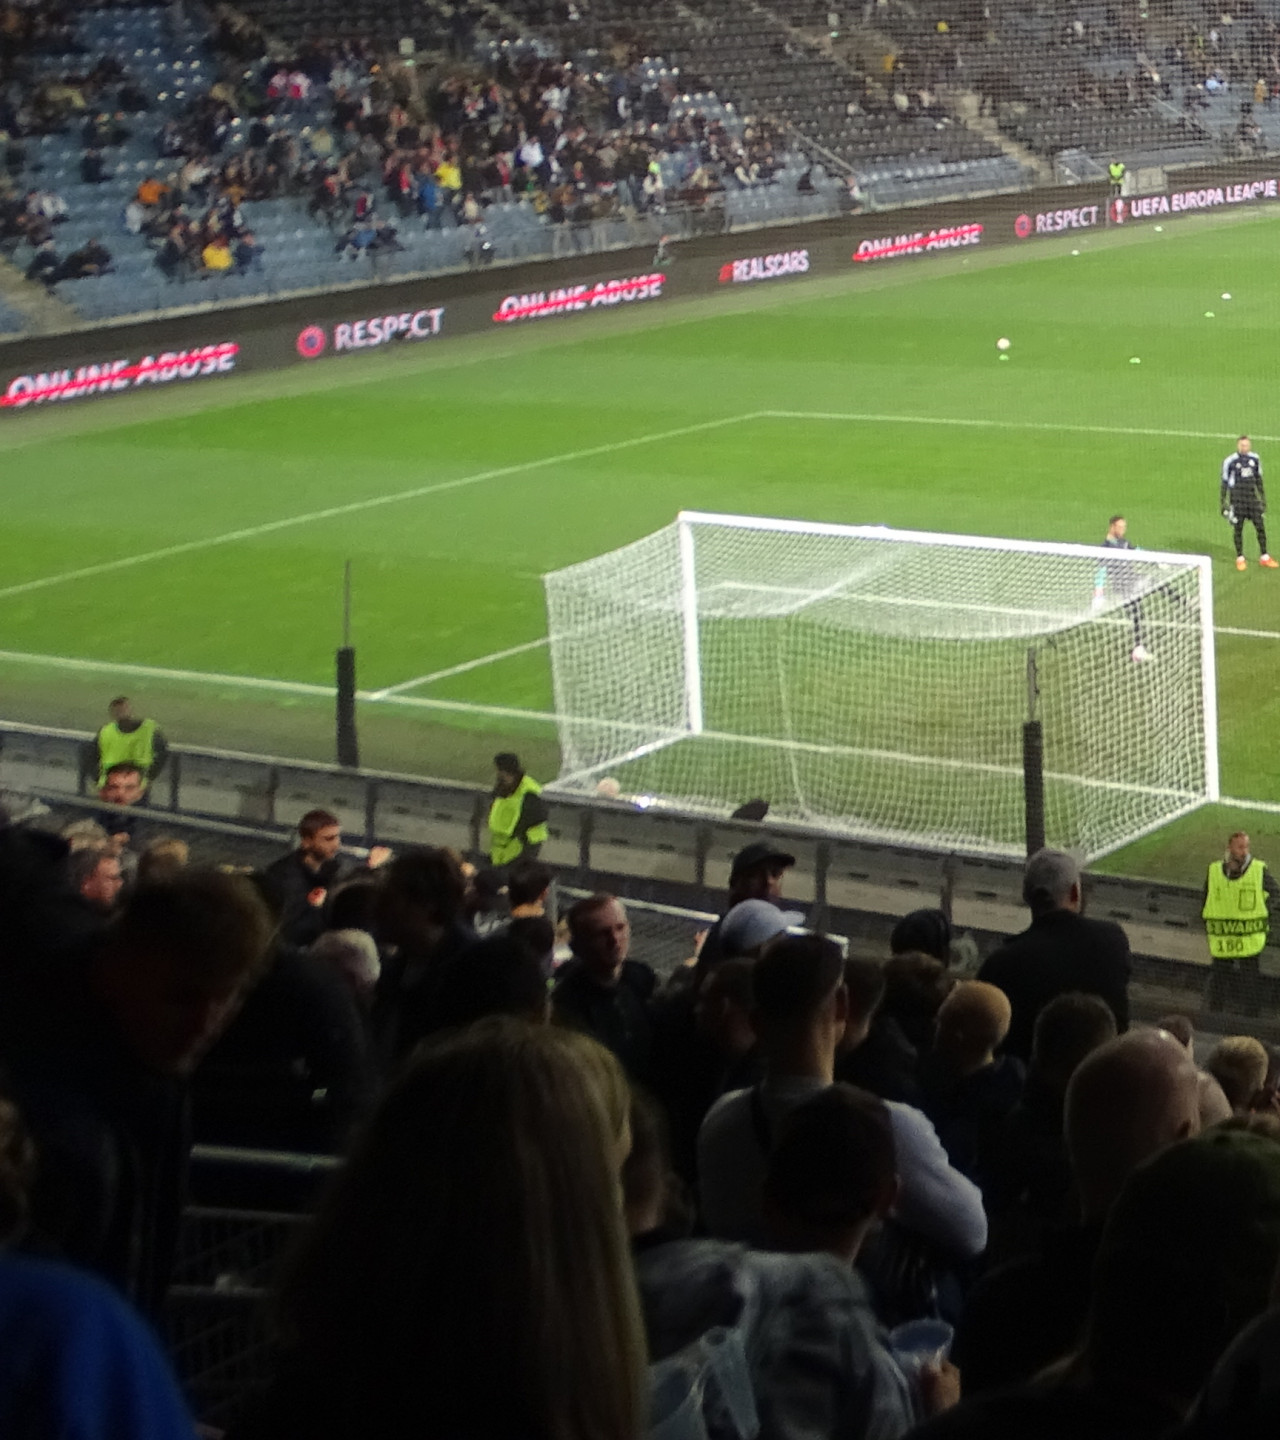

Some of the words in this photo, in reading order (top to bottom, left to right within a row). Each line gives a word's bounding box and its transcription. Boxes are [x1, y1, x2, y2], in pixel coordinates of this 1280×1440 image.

[1036, 206, 1098, 233] RESPECT
[1131, 195, 1169, 217] UEFA
[1172, 187, 1223, 212] EUROPA
[858, 231, 922, 262] ONLINE
[925, 223, 980, 252] ABUSE
[500, 284, 588, 322] ONLINE
[591, 263, 663, 307] ABUSE
[334, 307, 444, 351] RESPECT
[7, 359, 130, 408] ONLINE
[134, 342, 235, 386] ABUSE
